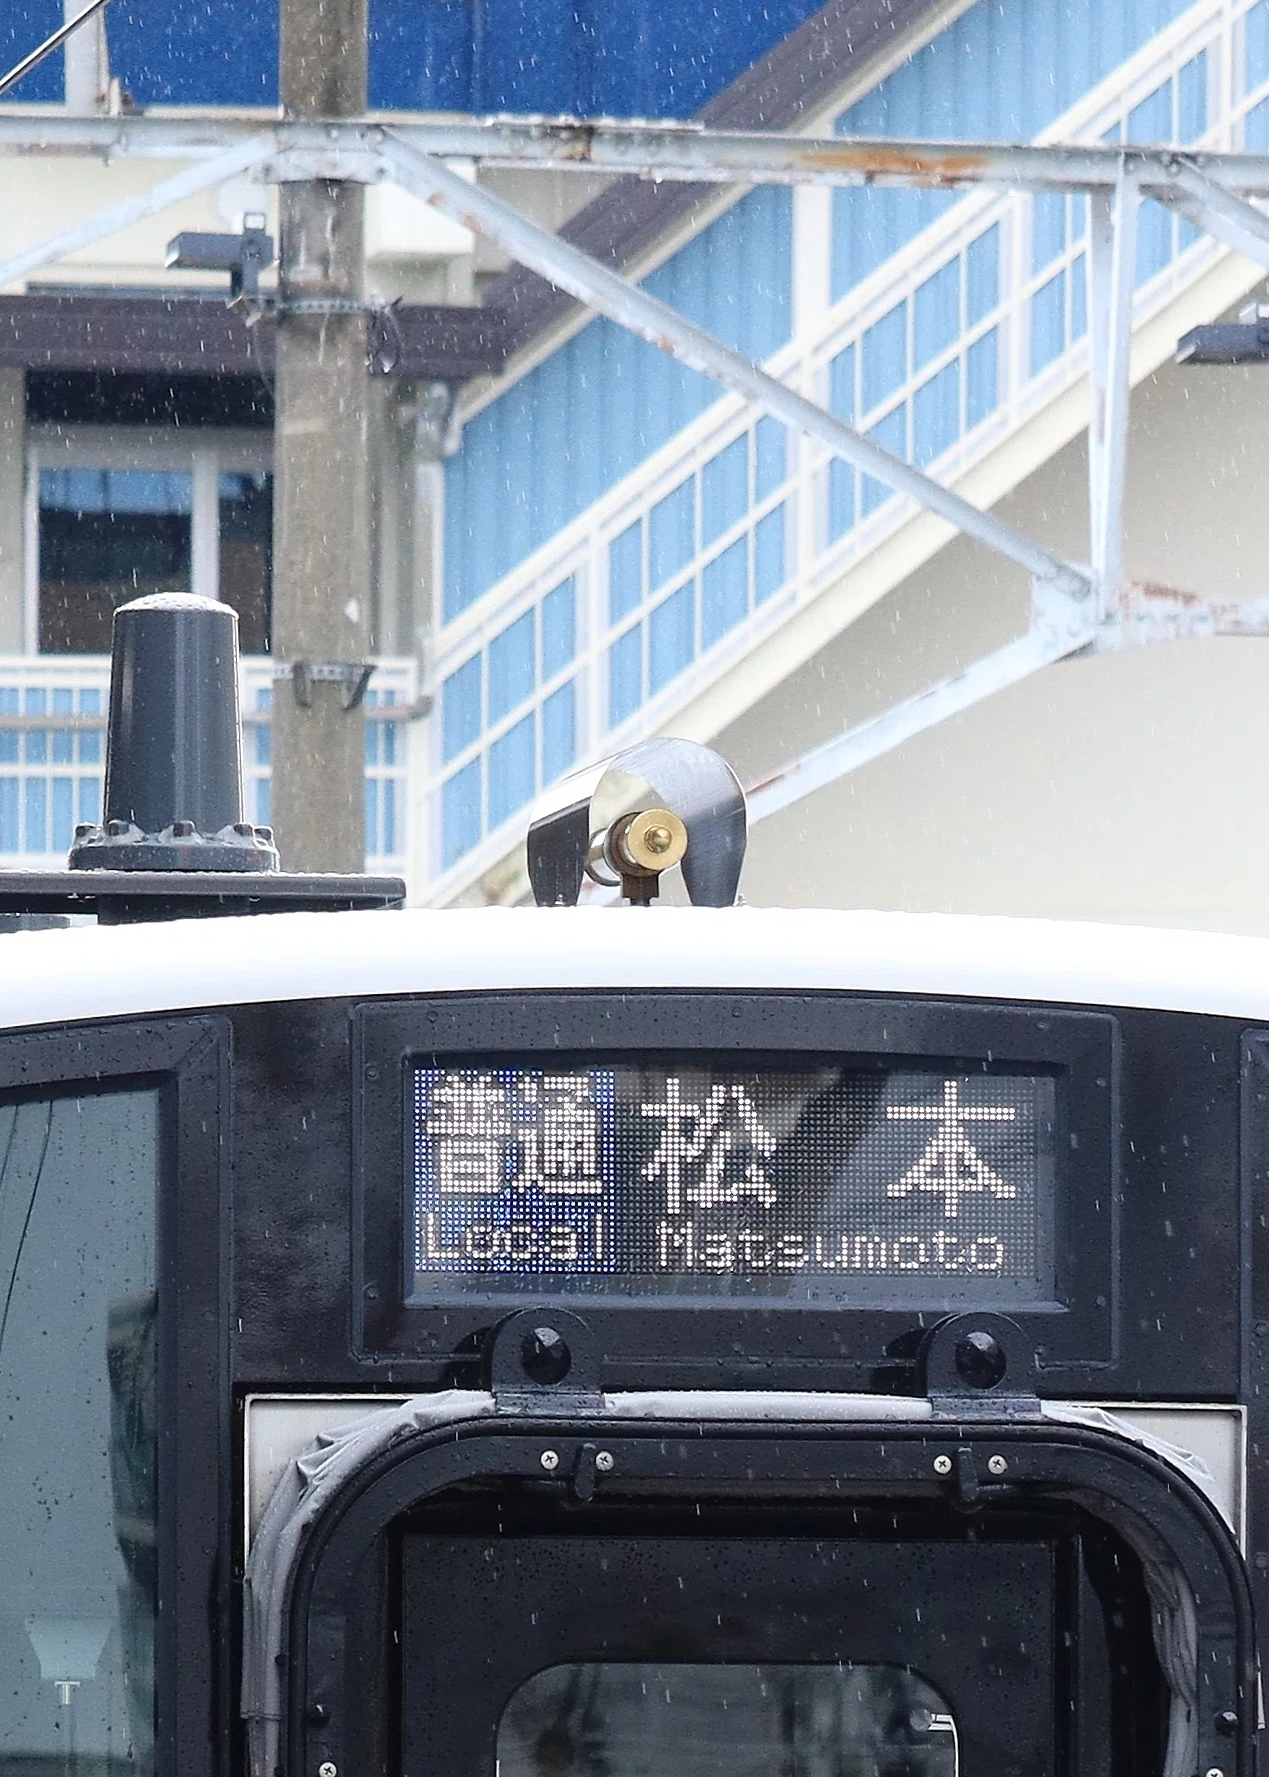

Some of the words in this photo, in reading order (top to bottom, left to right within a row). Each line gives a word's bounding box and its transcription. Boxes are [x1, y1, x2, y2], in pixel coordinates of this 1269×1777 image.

[424, 1074, 603, 1196] 普通
[639, 1077, 1017, 1219] 松本
[423, 1212, 605, 1263] Local
[654, 1220, 1006, 1270] Matsumoto
